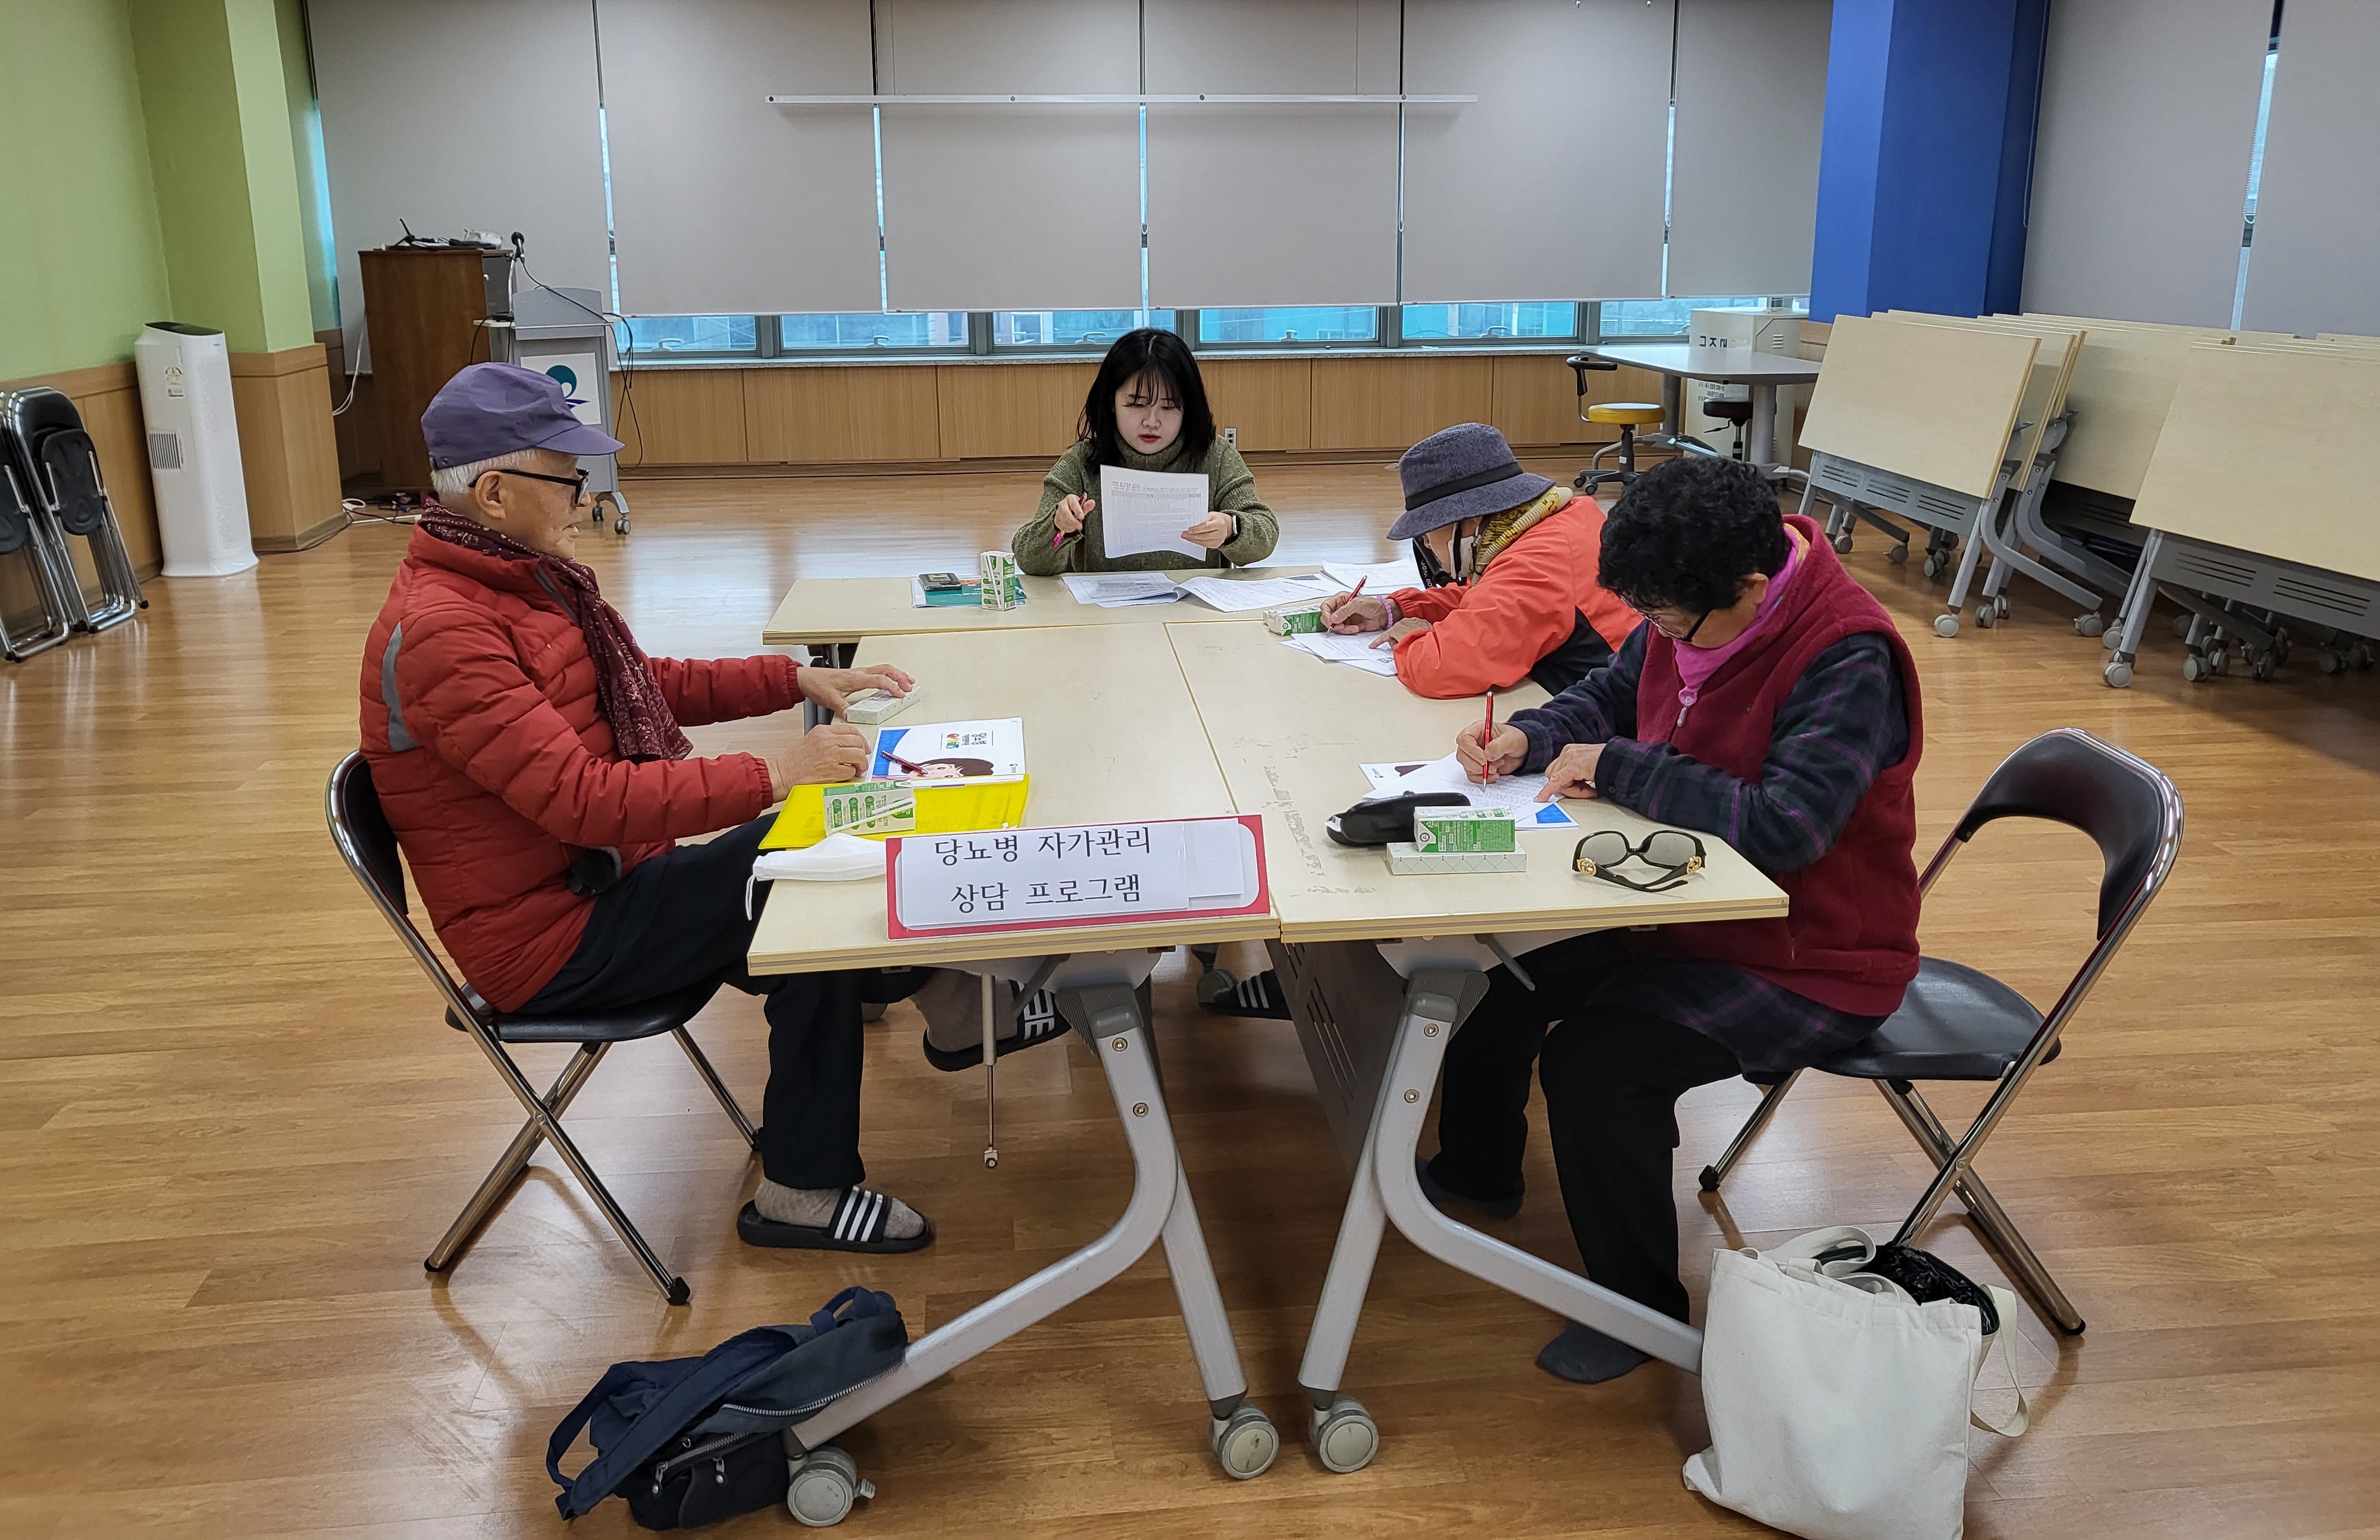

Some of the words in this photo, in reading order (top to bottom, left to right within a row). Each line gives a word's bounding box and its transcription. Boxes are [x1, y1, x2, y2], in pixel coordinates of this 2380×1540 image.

[934, 834, 1019, 866] 당뇨병
[1038, 826, 1151, 859] 자가관리
[951, 882, 1009, 913] 상담
[1025, 874, 1140, 904] 프로그램
